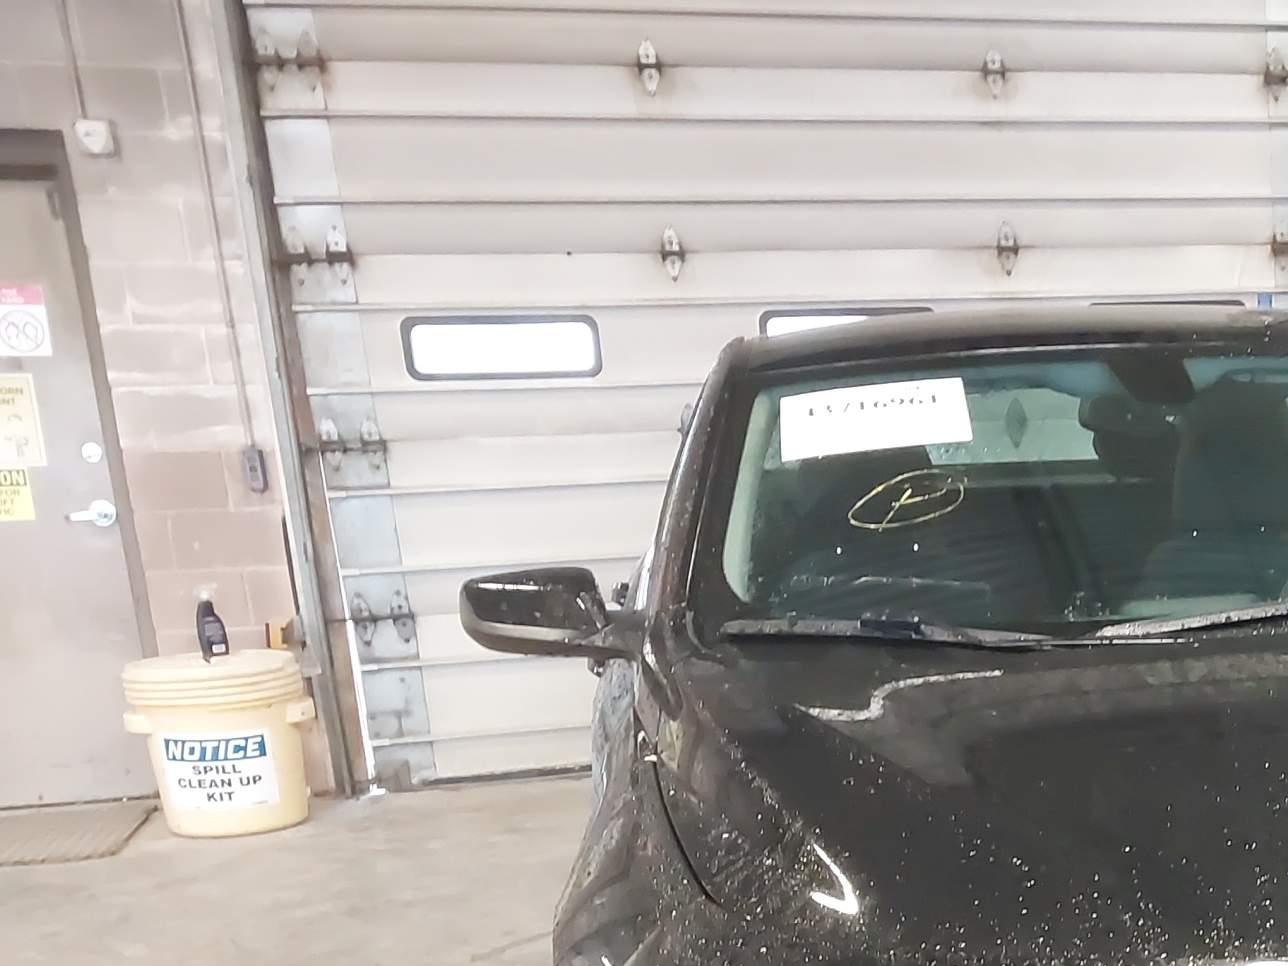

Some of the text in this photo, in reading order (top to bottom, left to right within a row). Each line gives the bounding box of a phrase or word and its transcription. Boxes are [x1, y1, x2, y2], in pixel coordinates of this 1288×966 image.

[166, 737, 262, 760] NOTICE
[192, 764, 242, 776] SPILL
[178, 774, 263, 790] CLEAN UP
[206, 791, 234, 803] KIT
